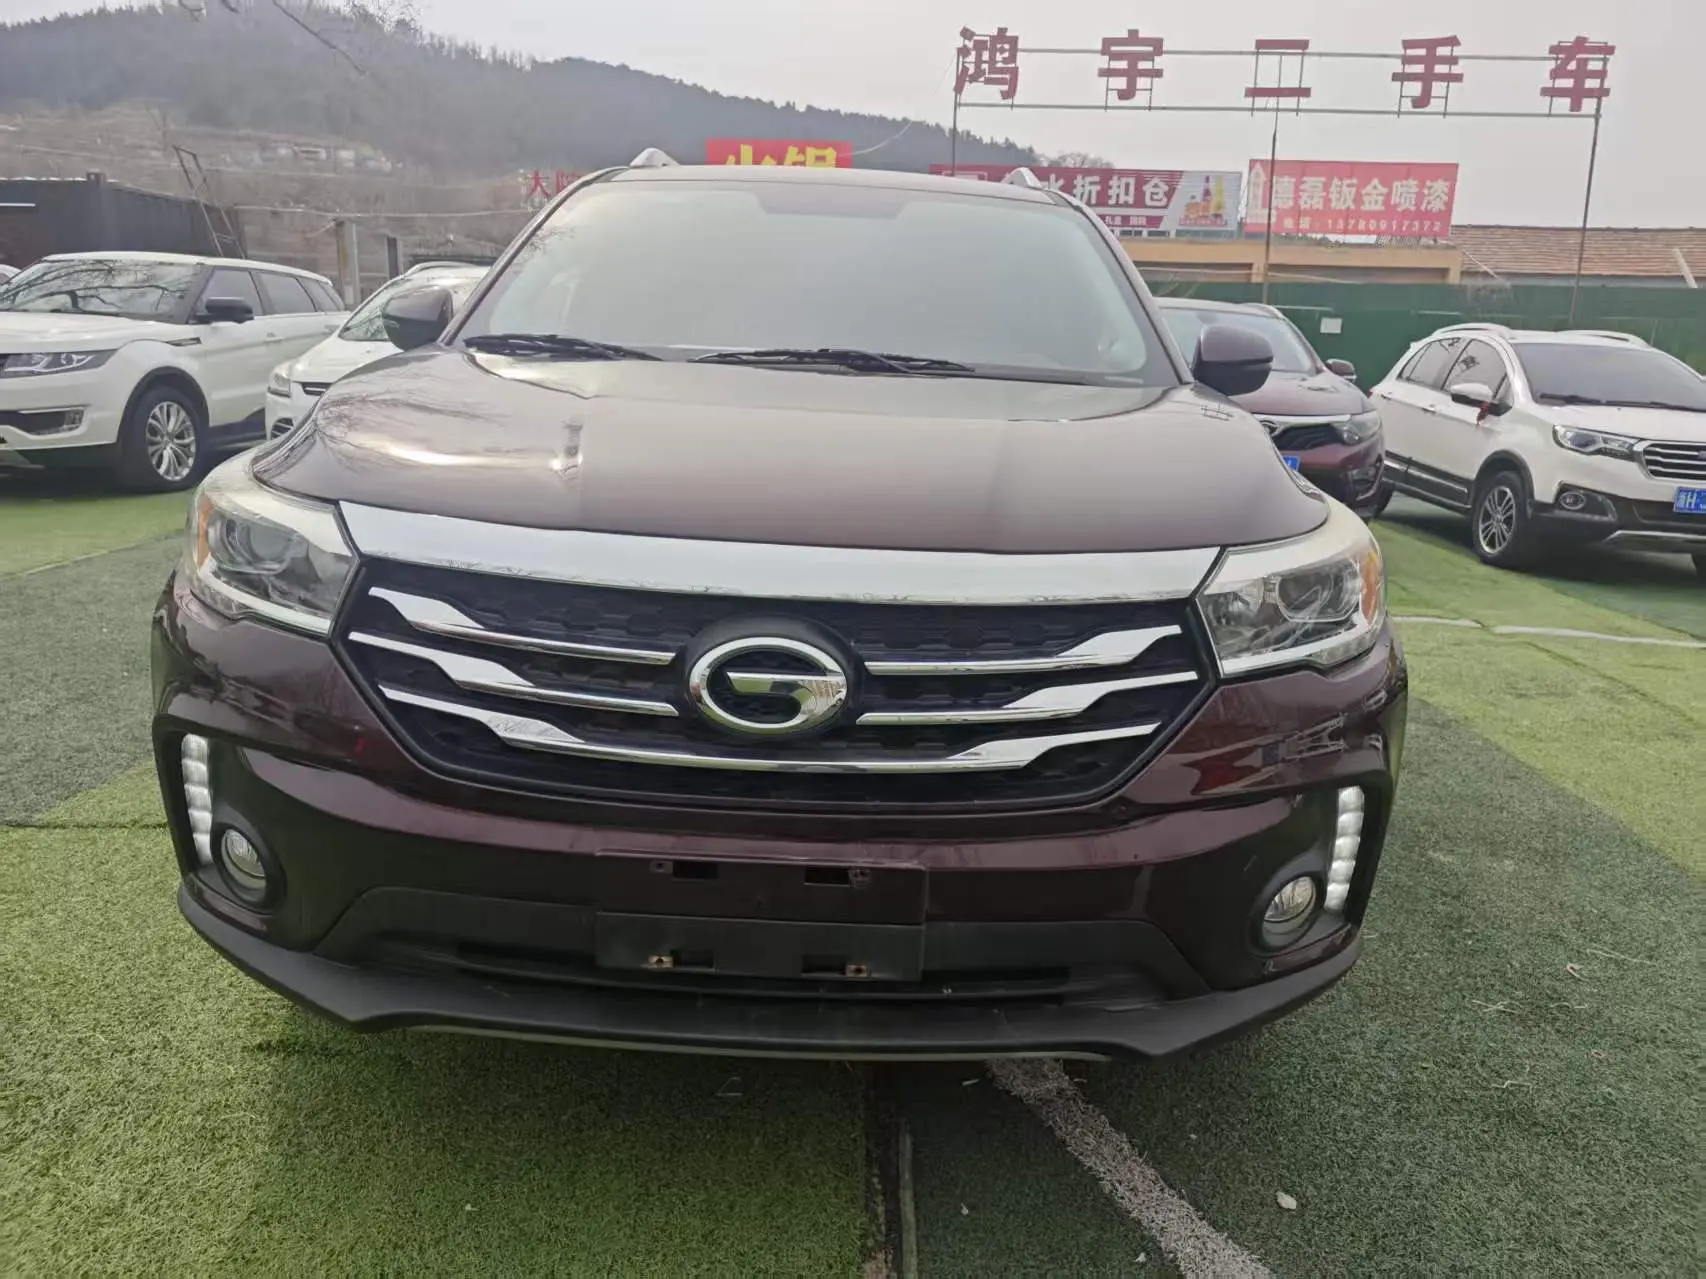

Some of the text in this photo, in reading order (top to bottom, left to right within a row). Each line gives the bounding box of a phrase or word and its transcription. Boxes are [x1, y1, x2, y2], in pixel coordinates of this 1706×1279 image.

[953, 26, 1616, 112] 鸿宇二手车
